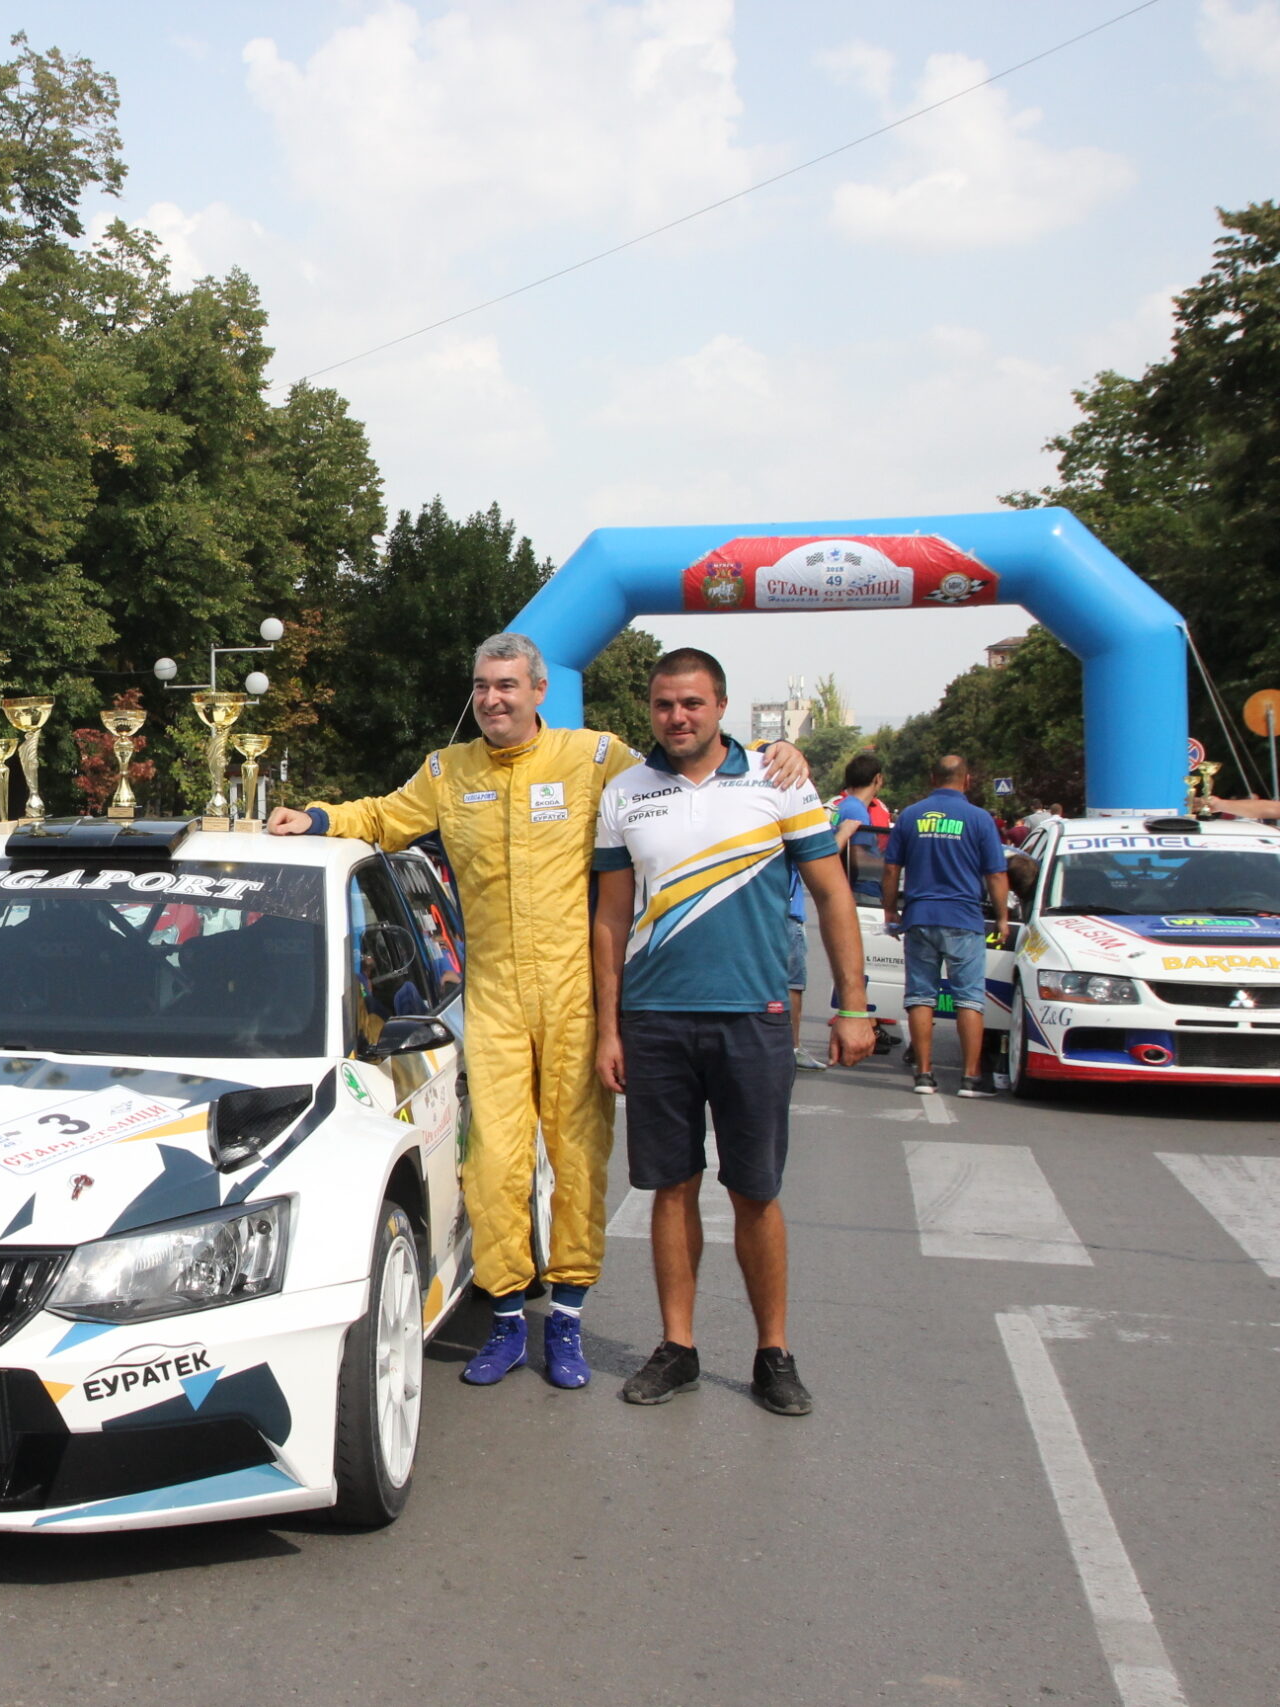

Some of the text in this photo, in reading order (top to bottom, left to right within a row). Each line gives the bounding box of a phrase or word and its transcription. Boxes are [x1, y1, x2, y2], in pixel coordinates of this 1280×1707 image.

[767, 579, 900, 597] СТАРИ СТОЛИЦИ
[826, 576, 842, 586] 49
[631, 786, 683, 804] ŠKODA
[1067, 836, 1208, 851] DIANEL
[1054, 918, 1128, 950] BULSIM
[872, 956, 905, 965] ПАНТЕЛЕЕ
[1041, 1004, 1073, 1026] Z&G
[38, 1113, 91, 1135] 3
[3, 1140, 76, 1167] СТАРИ
[82, 1105, 167, 1144] СТОЛИЦИ
